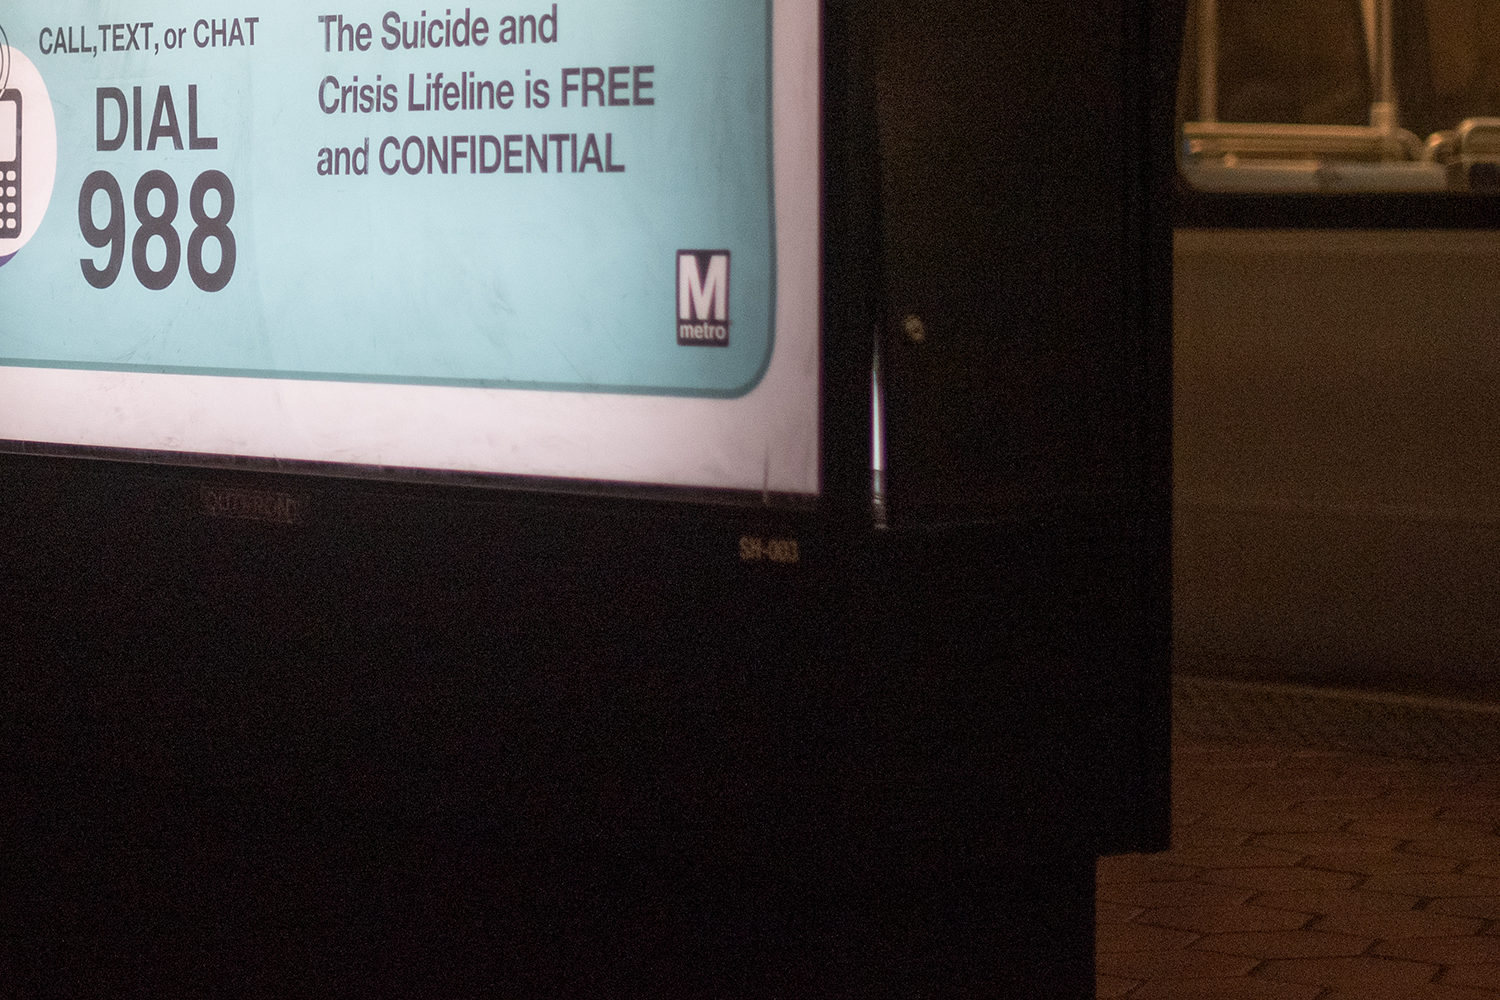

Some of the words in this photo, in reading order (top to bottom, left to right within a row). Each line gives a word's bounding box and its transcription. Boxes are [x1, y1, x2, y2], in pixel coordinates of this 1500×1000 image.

[163, 26, 187, 50] or
[193, 16, 260, 49] CHAT
[318, 13, 373, 53] The
[381, 7, 490, 50] Suicide
[498, 3, 558, 46] and
[318, 74, 398, 115] Crisis
[408, 71, 515, 112] Lifeline
[525, 69, 551, 109] is
[561, 64, 656, 108] FREE
[95, 84, 218, 152] DIAL
[316, 137, 370, 177] and
[378, 132, 626, 176] CONFIDENTIAL
[77, 169, 237, 293] 988
[679, 254, 727, 320] M
[680, 322, 726, 340] metro
